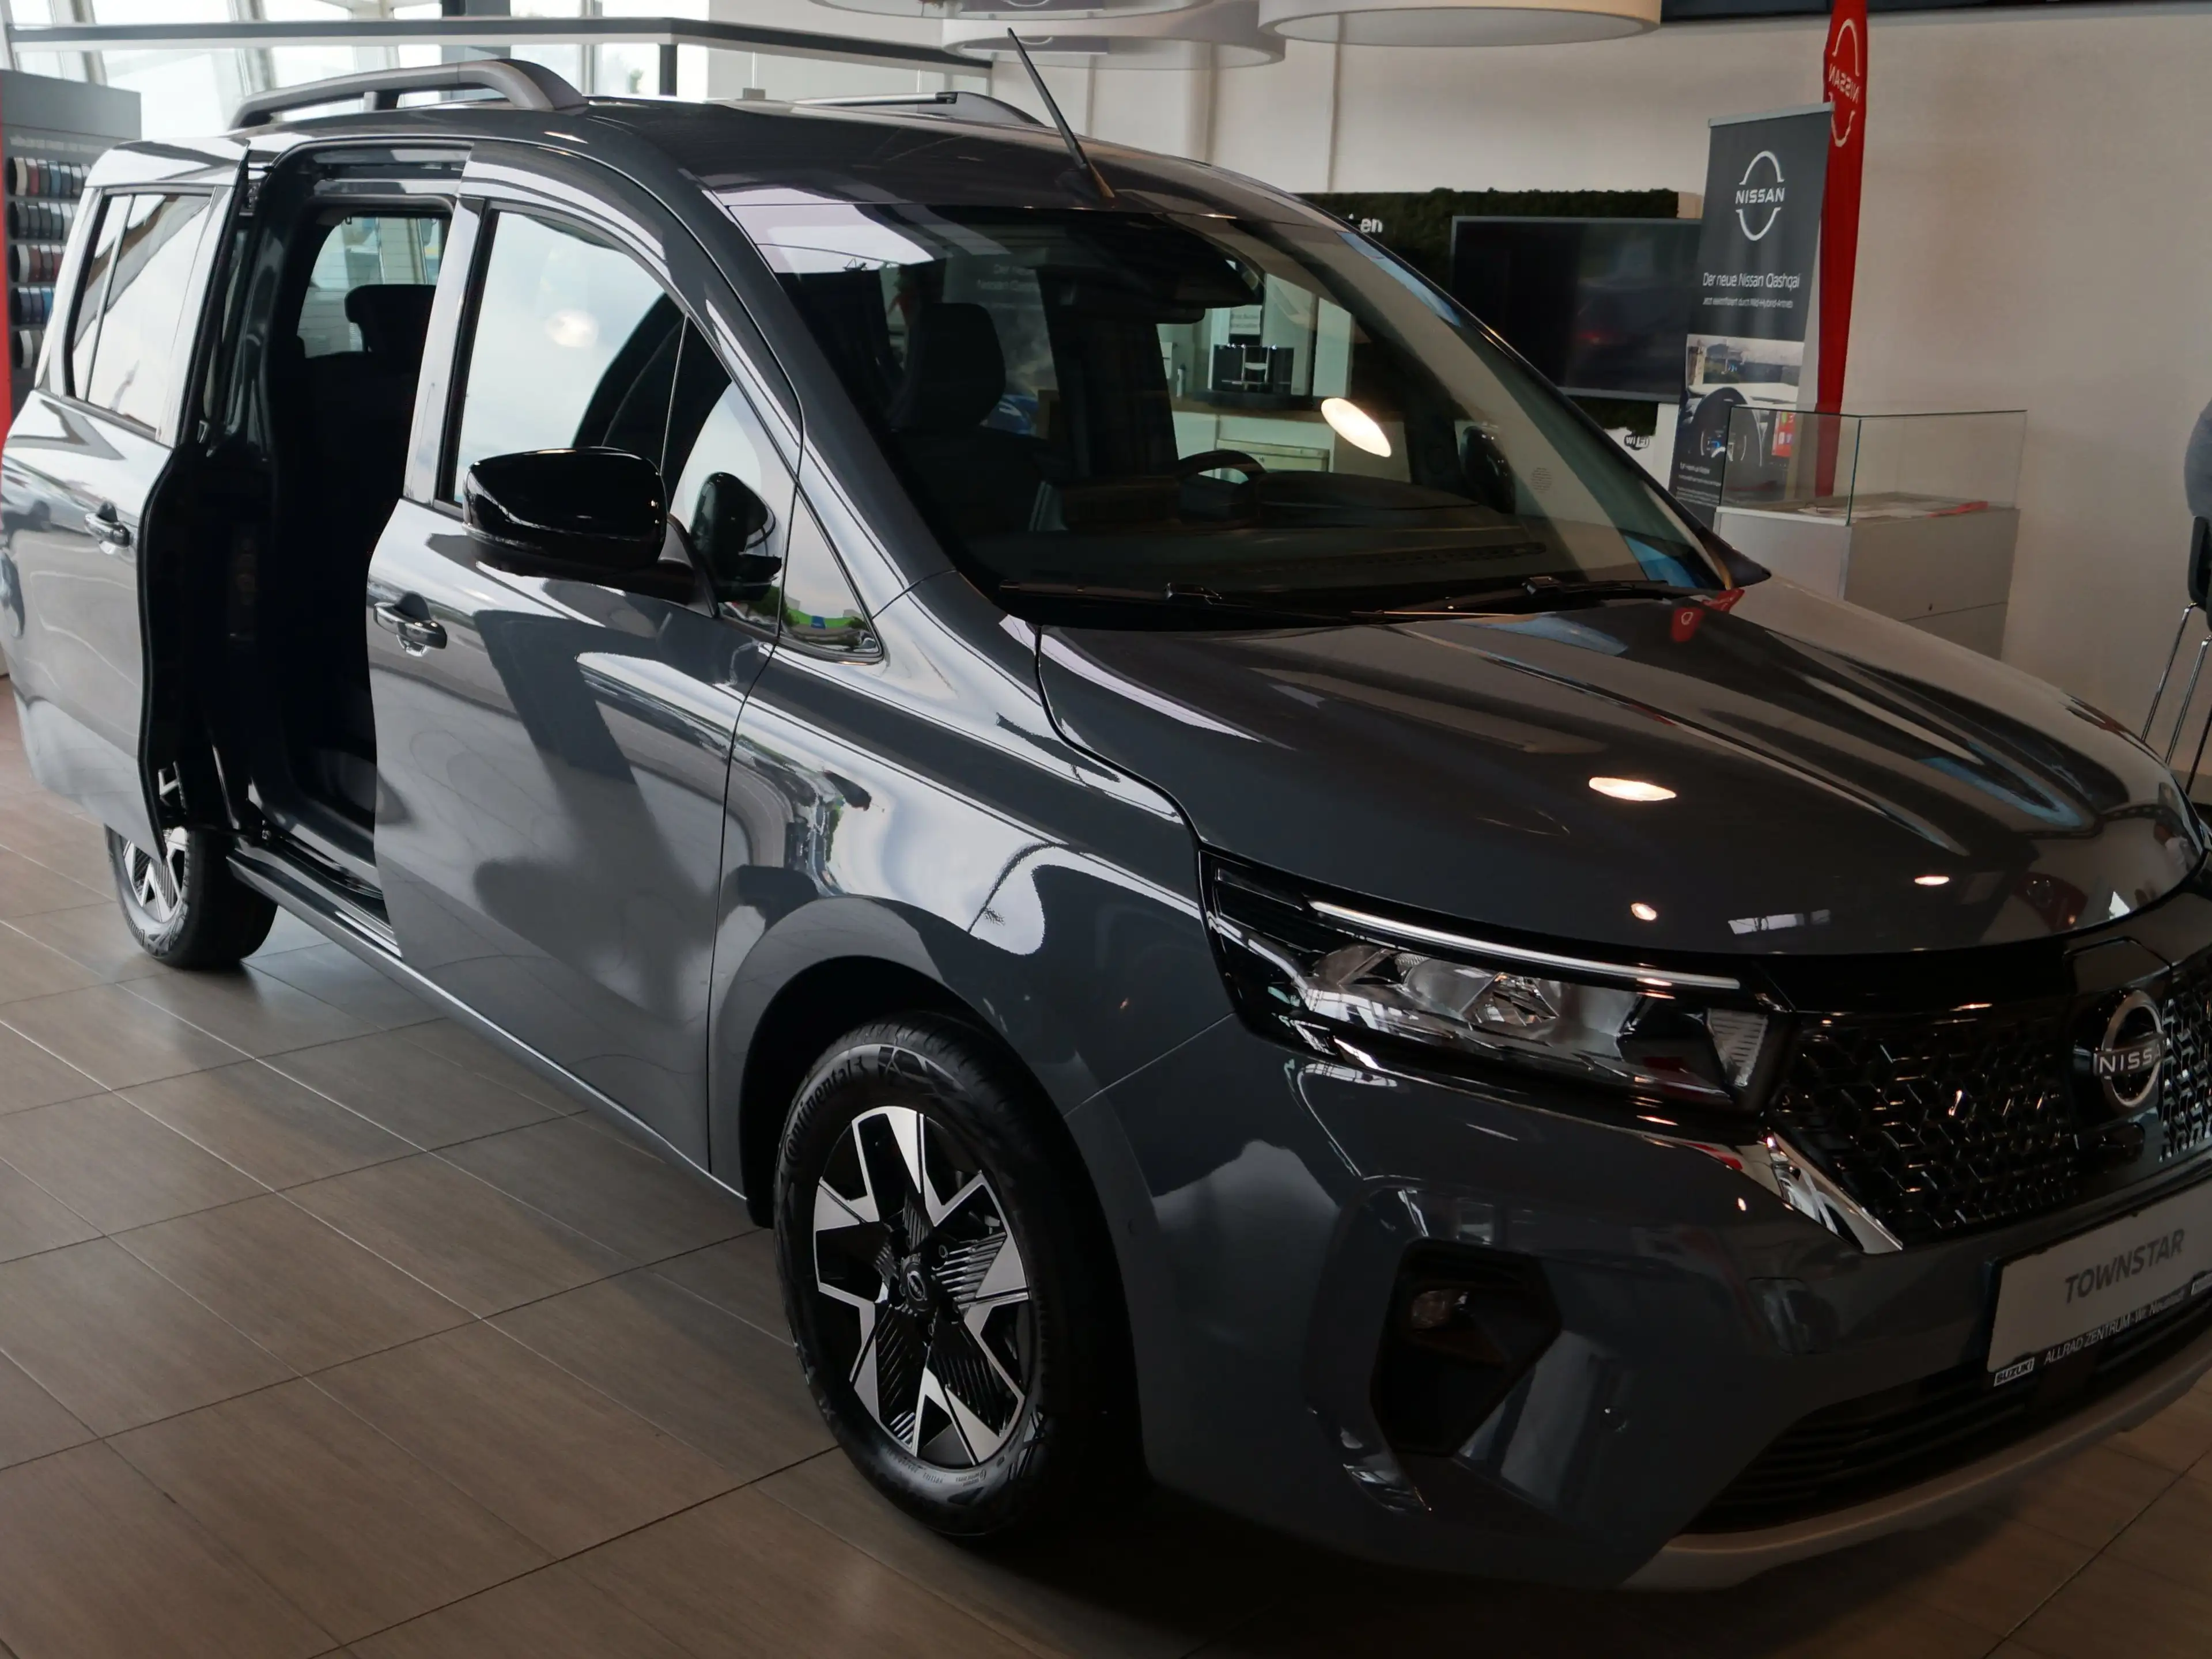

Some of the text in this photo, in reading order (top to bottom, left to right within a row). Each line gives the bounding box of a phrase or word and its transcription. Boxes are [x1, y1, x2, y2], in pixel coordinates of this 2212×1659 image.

[1735, 188, 1785, 204] NISSAN
[1703, 272, 1801, 291] Der neue Nissan Qashqai
[785, 1059, 852, 1164] Continental
[2064, 1228, 2185, 1304] TOWNSTAR
[1995, 1358, 2034, 1384] SUZUKI
[2044, 1337, 2084, 1365] ALLRAD
[2084, 1315, 2131, 1348] ZENTRUM
